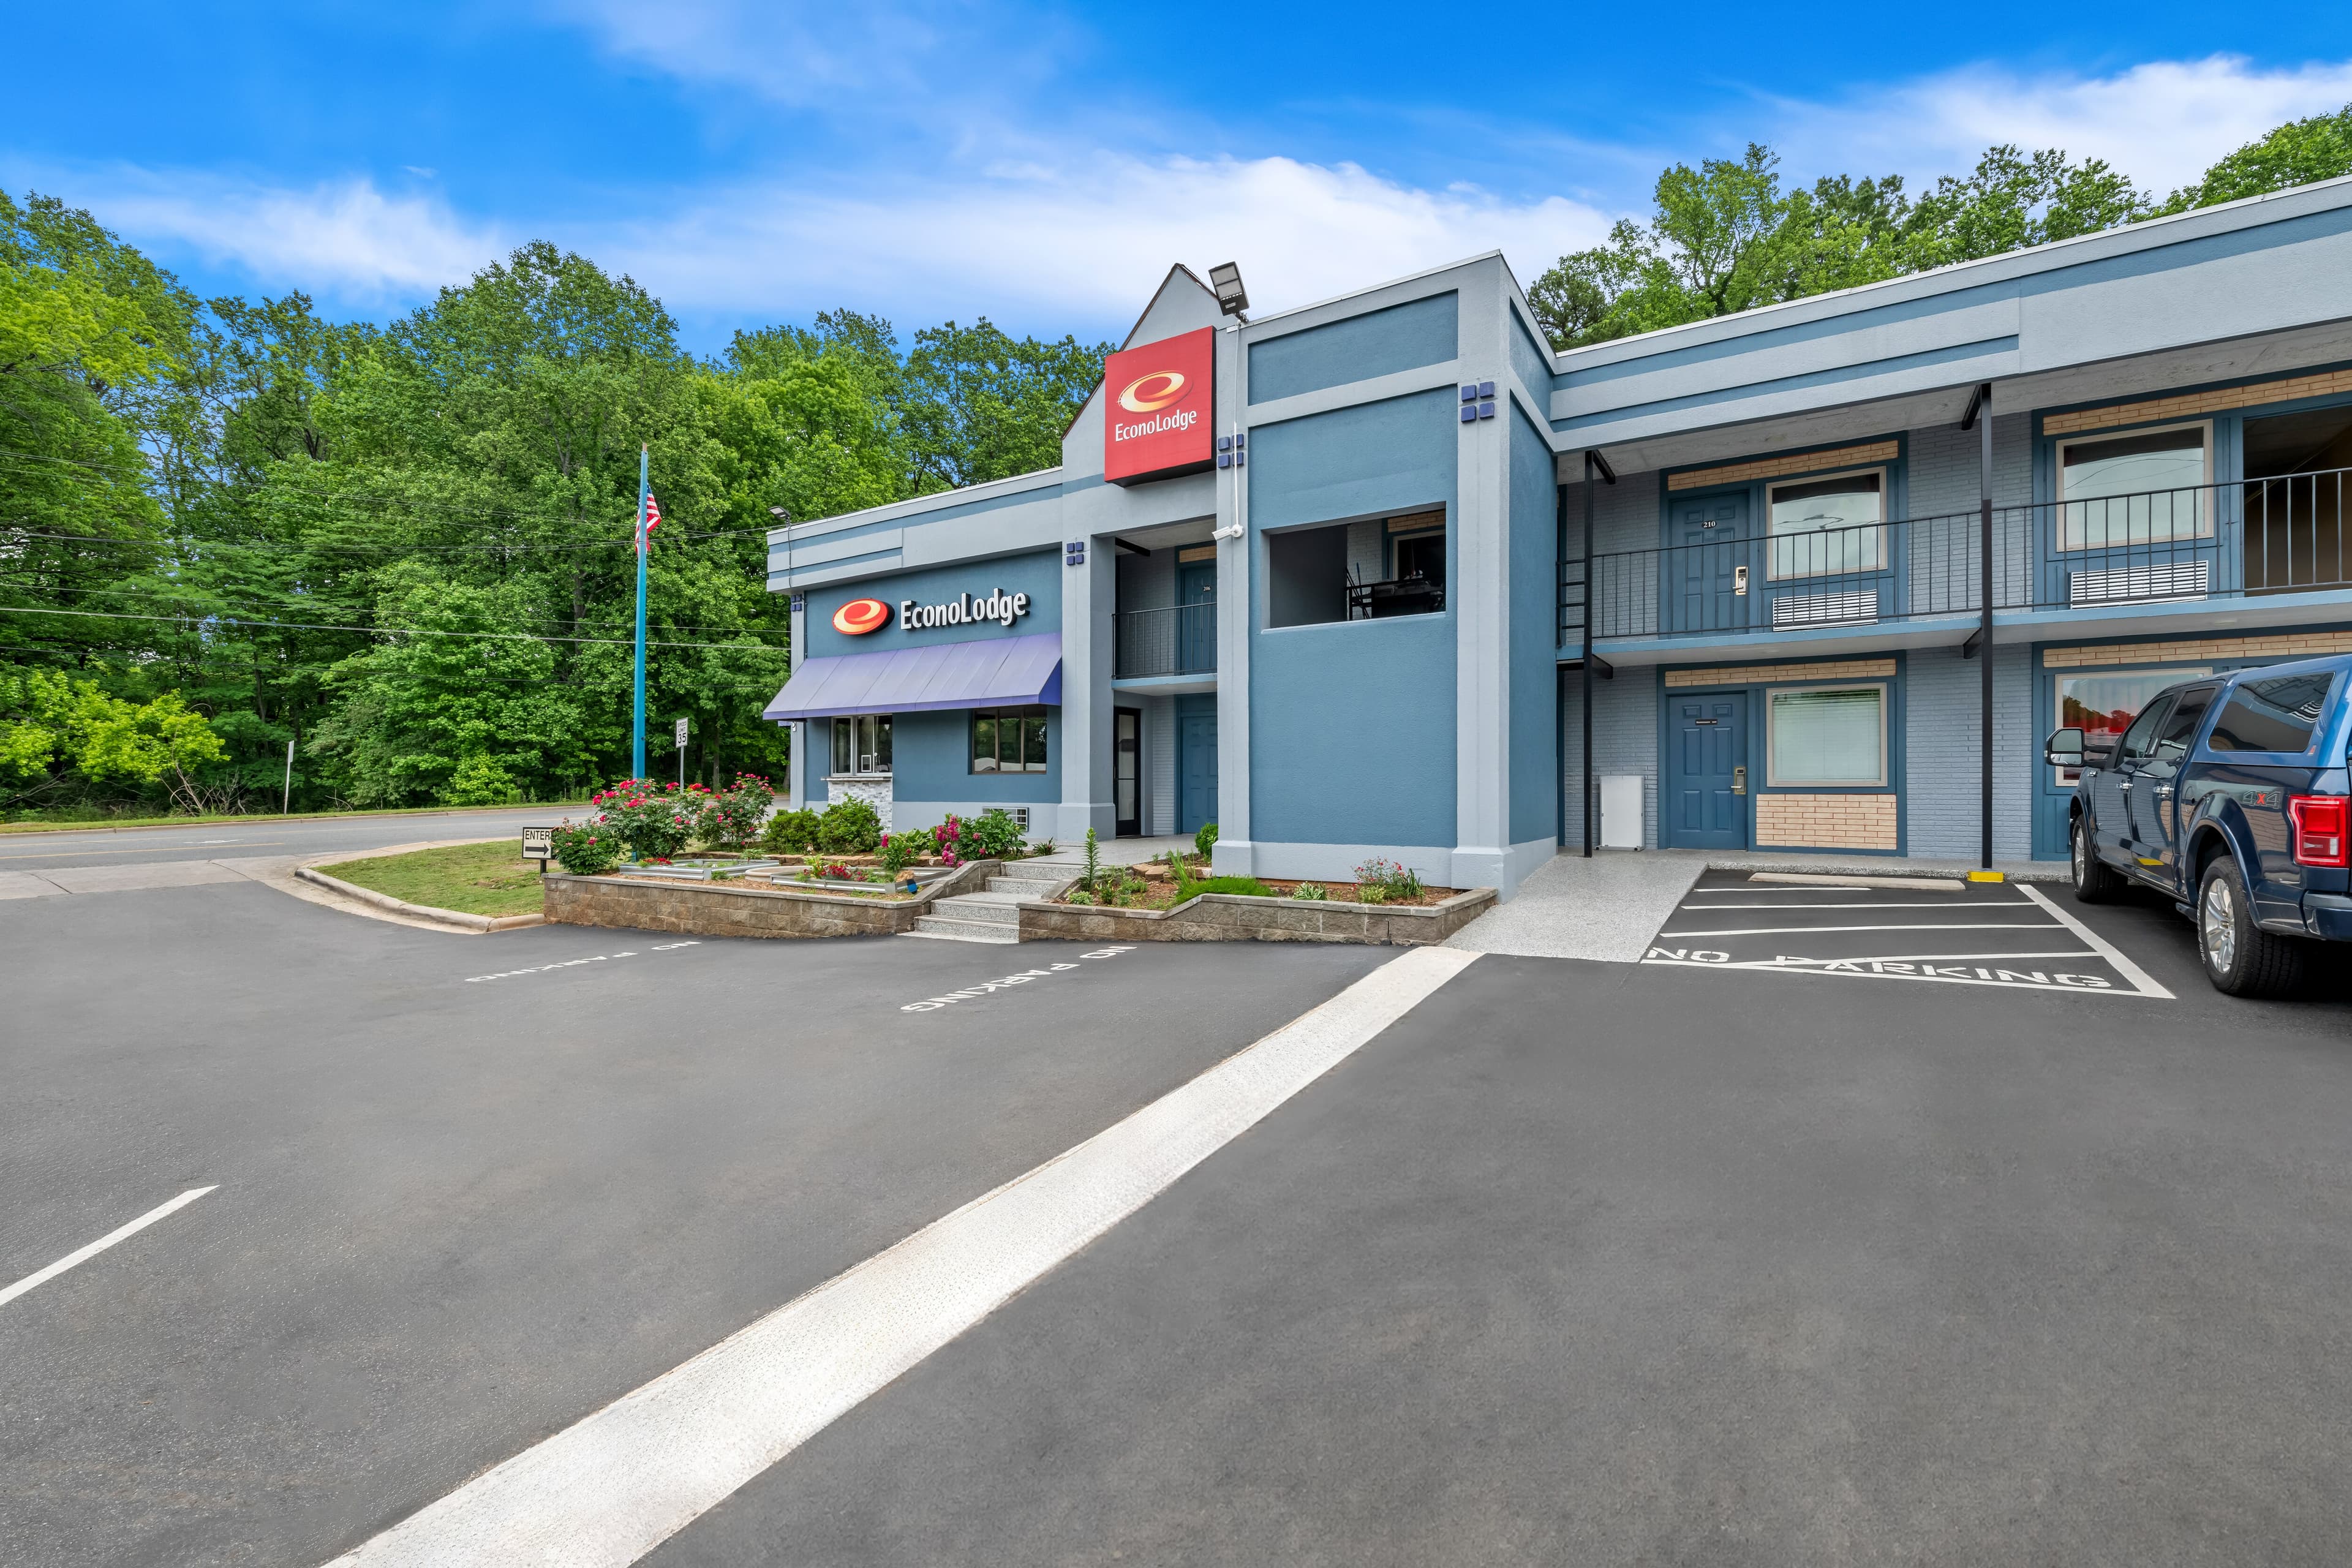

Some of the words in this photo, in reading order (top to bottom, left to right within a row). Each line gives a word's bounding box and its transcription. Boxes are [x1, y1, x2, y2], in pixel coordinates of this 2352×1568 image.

[678, 733, 687, 744] 35
[525, 830, 550, 840] ENTER
[651, 941, 702, 951] NO
[1079, 946, 1137, 959] NO
[1648, 947, 1730, 962] NO
[1776, 955, 2112, 988] PARKING
[900, 963, 1081, 1012] PARKING
